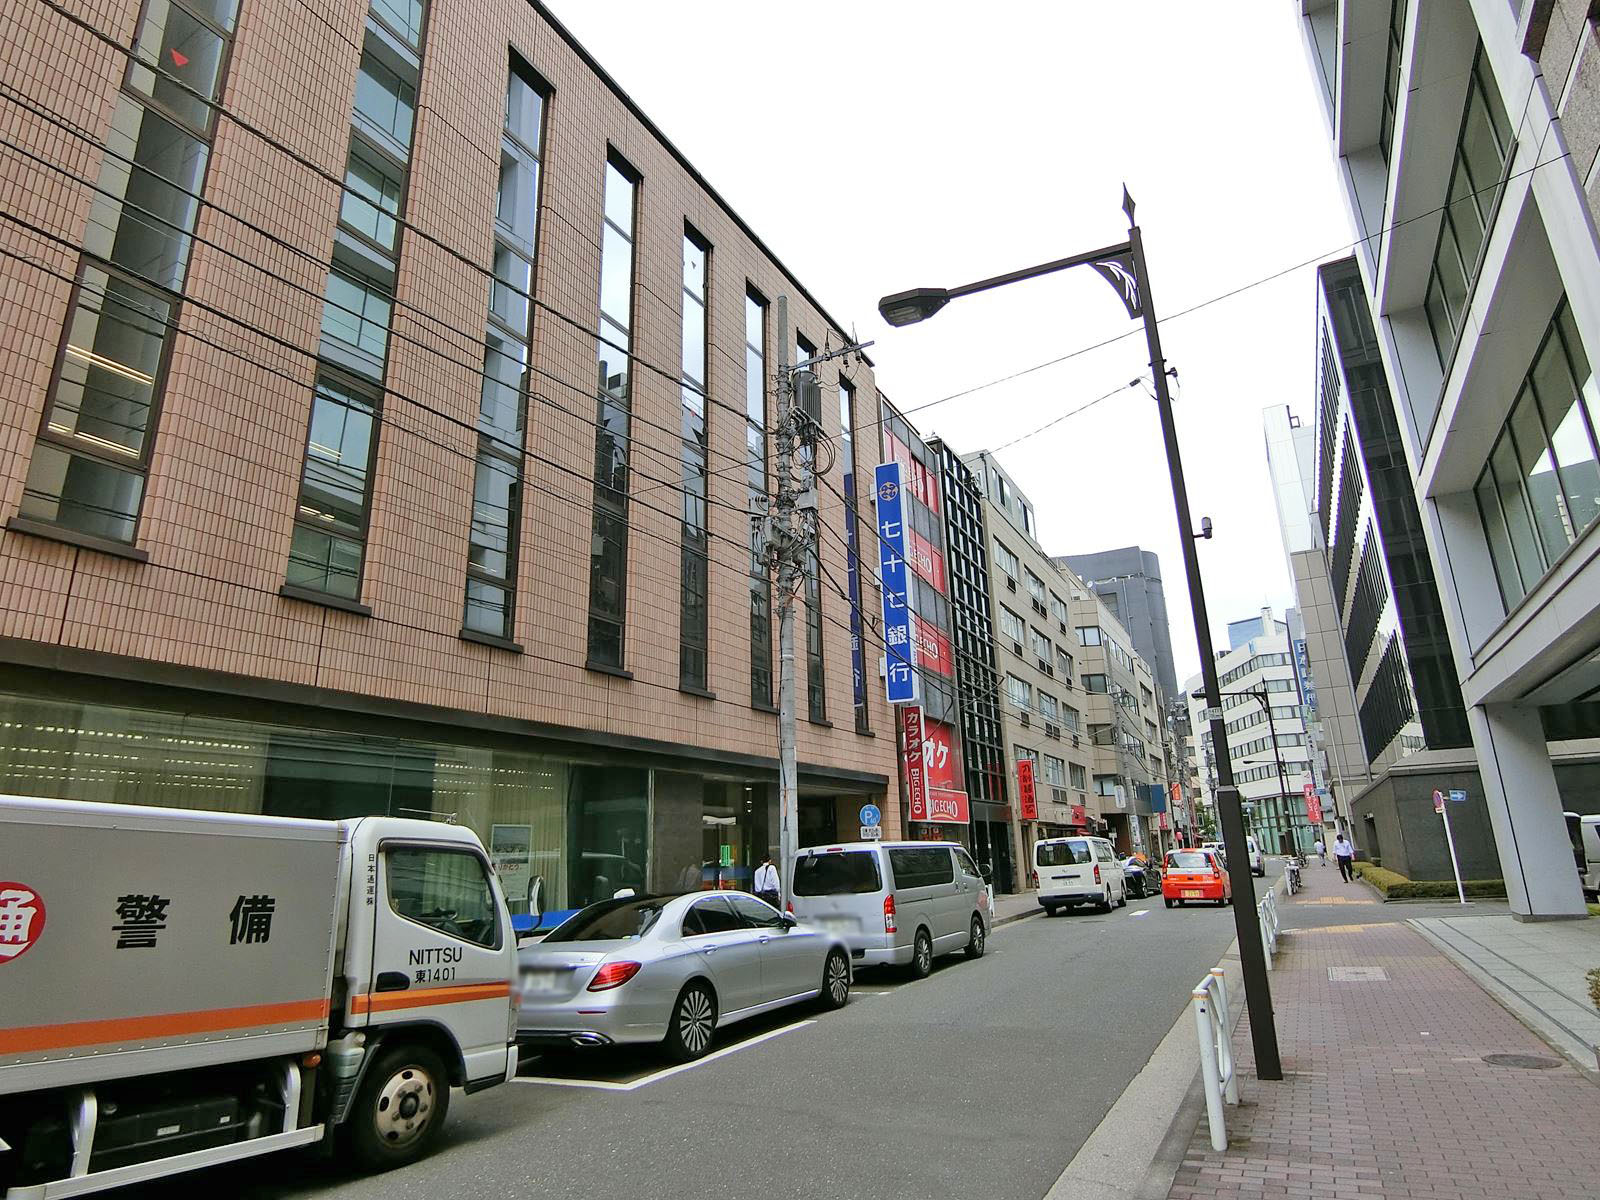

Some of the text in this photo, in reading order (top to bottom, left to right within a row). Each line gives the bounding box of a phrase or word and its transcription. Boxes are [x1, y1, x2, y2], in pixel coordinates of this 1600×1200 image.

[880, 520, 910, 683] 七十七銀行
[907, 712, 921, 763] カラオケ
[930, 799, 958, 818] IGECHO
[111, 894, 276, 950] 警備
[408, 947, 462, 966] NITTSU
[415, 967, 455, 984] 東1401
